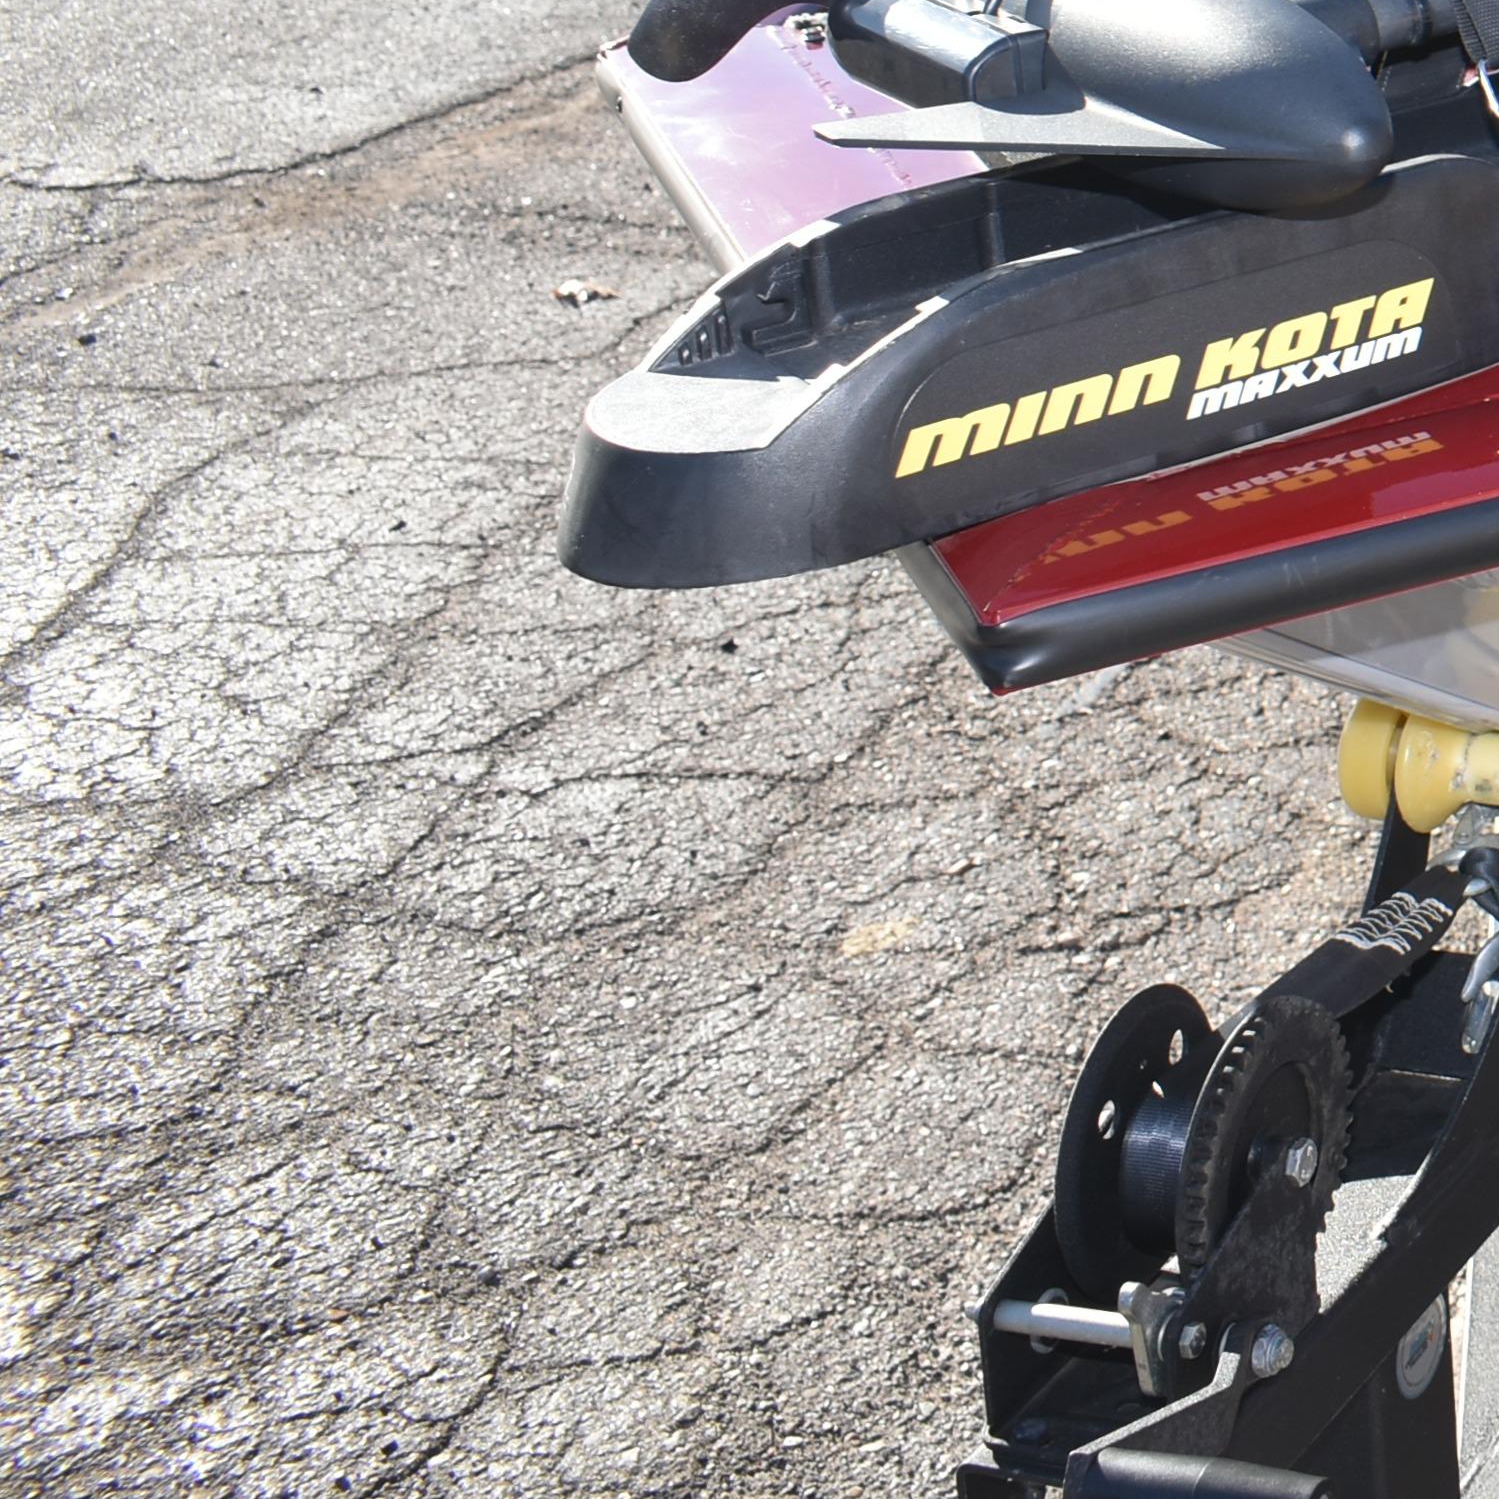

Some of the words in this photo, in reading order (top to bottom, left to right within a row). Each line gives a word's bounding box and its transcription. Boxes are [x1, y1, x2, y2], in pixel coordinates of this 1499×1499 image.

[895, 354, 1181, 478] MINN
[1195, 278, 1434, 390] KOTA
[1187, 326, 1422, 420] MAXXUM
